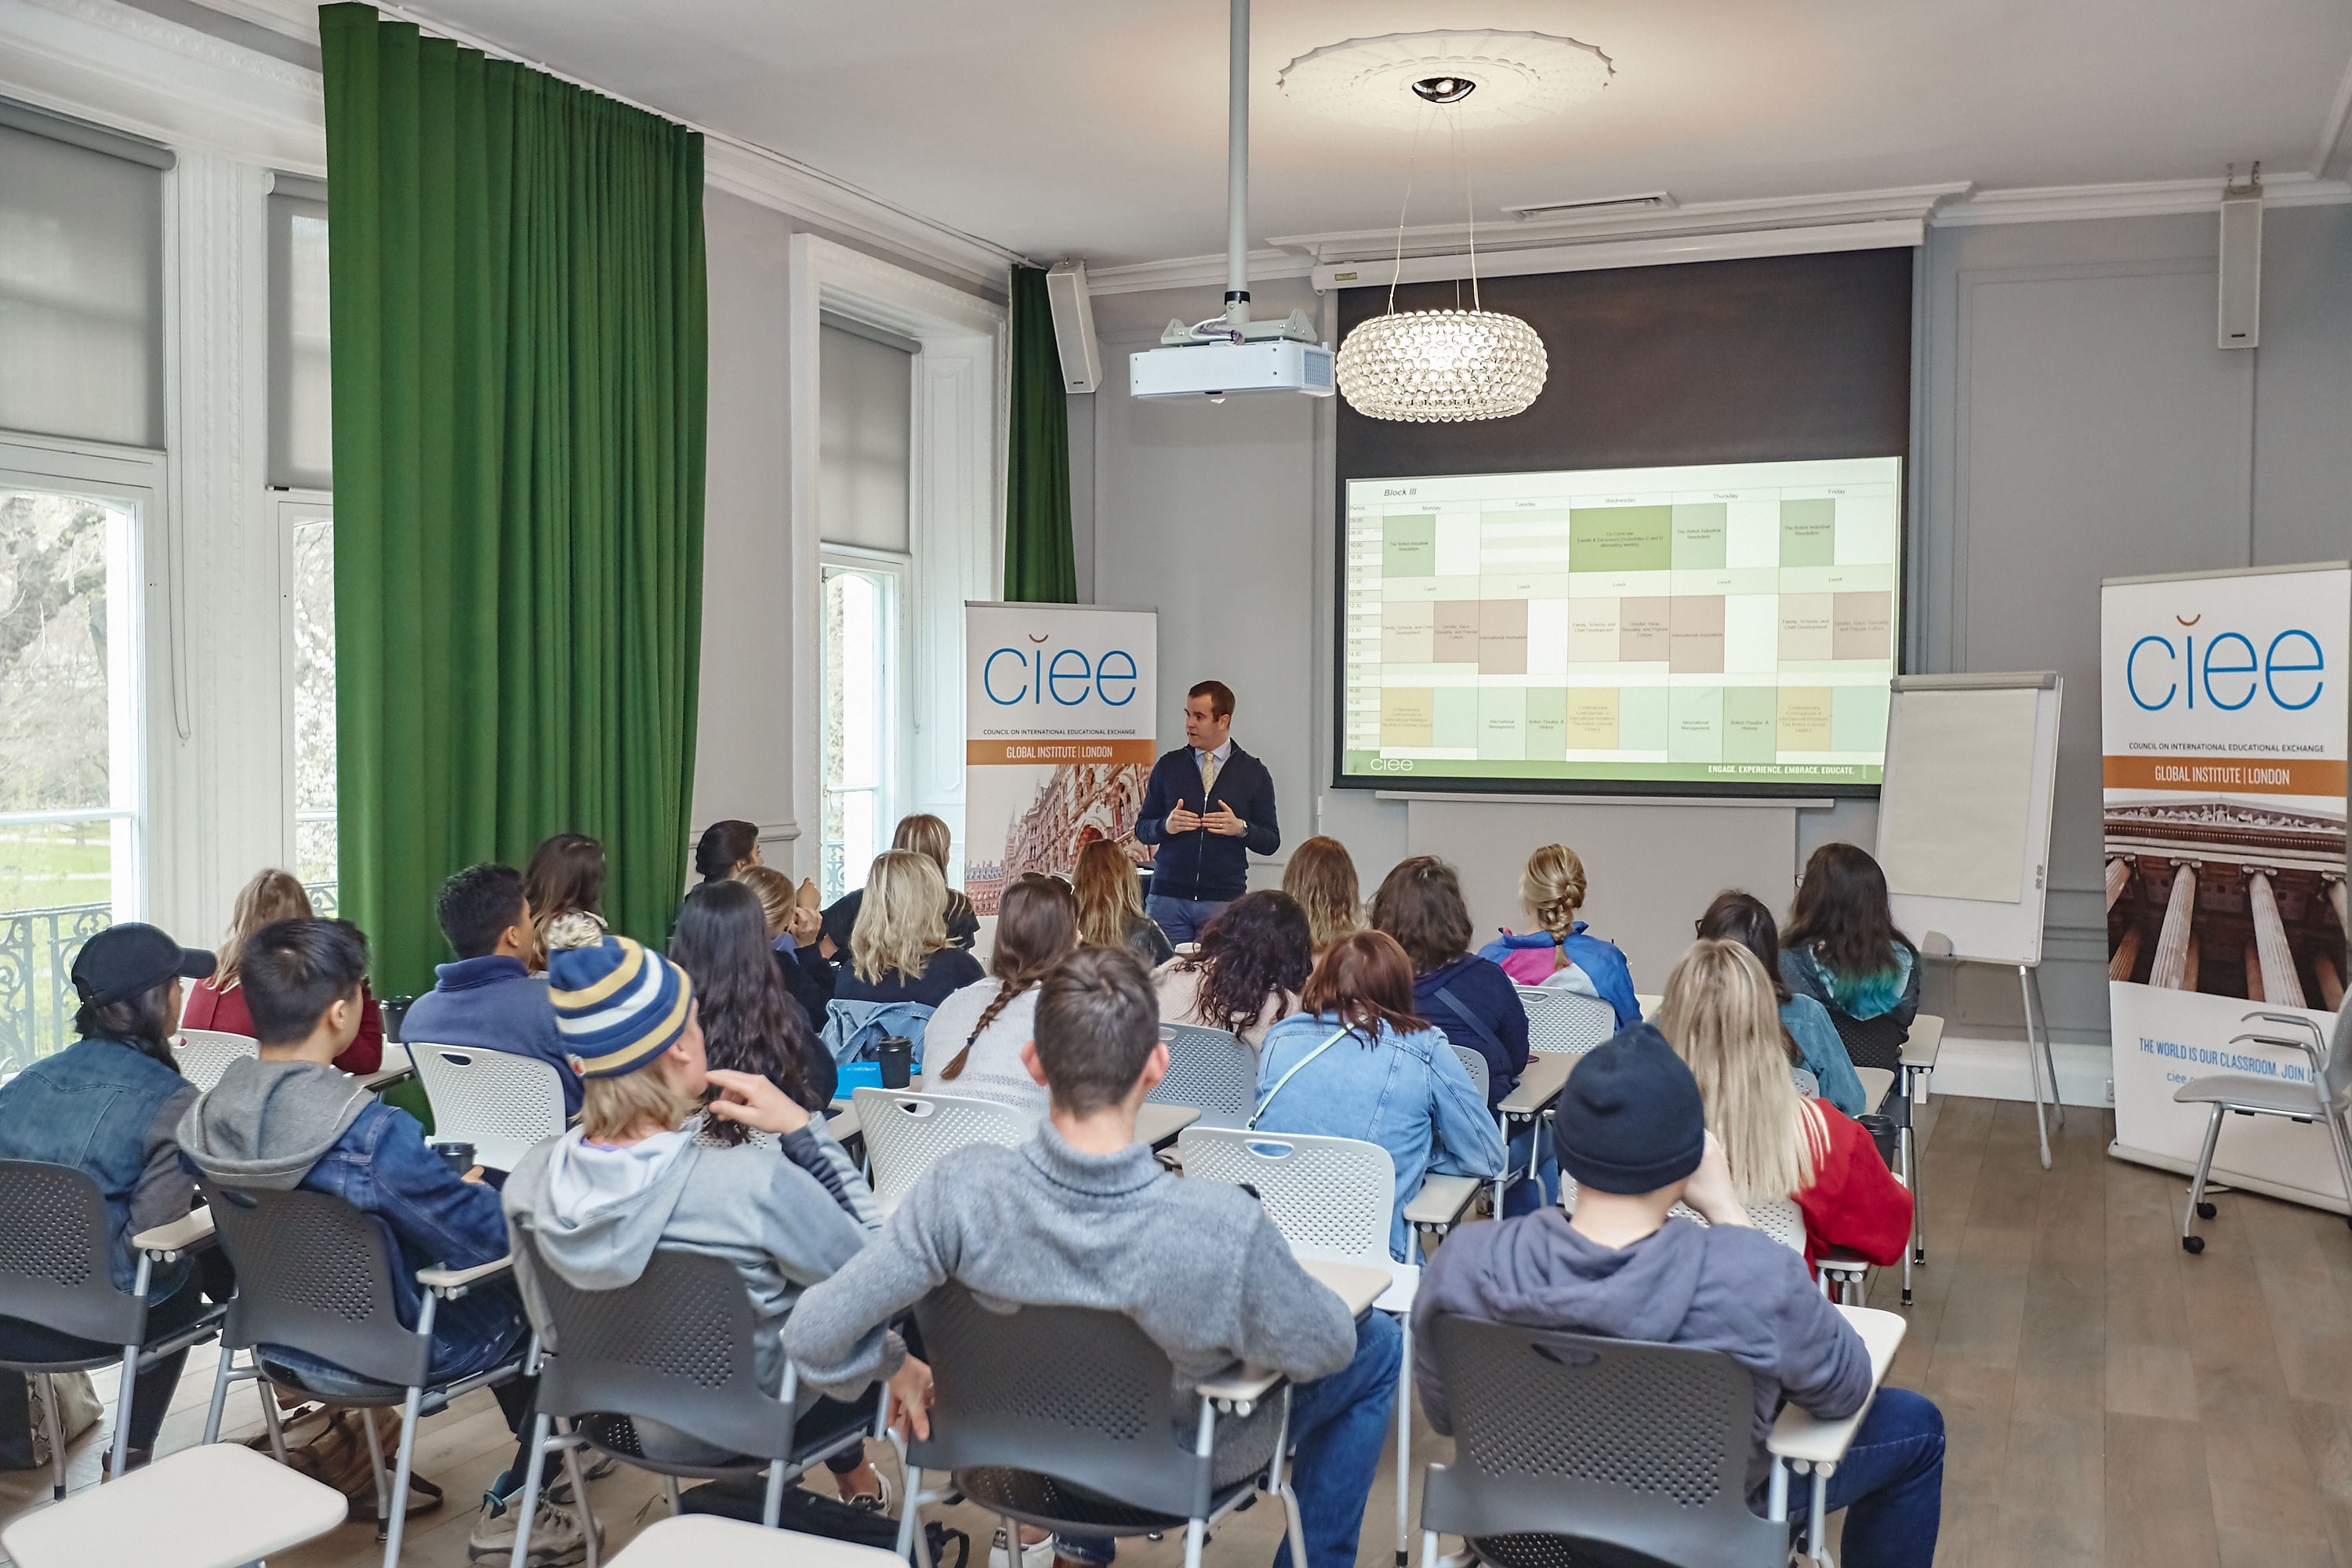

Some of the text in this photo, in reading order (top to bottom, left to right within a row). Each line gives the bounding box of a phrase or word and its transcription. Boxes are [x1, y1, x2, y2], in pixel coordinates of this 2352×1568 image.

[984, 634, 1137, 706] ciee
[2127, 614, 2324, 711] ciee
[1006, 746, 1112, 759] GLOBAL INSTITUTE LONDON
[2170, 742, 2227, 751] INTERNATIONAL
[2281, 744, 2325, 753] EXCHANGE
[1739, 765, 1783, 774] EXPERIENCE.
[1784, 766, 1820, 775] EMBRACE.
[1821, 766, 1855, 775] EDUCATE.
[2154, 765, 2290, 786] GLOBAL INSTITUTE LONDON
[2139, 1037, 2154, 1054] THE
[2156, 1040, 2187, 1059] WORLD
[2189, 1047, 2198, 1062] IS
[2199, 1048, 2218, 1065] OUR
[2220, 1051, 2278, 1076] CLASSROOM.
[2281, 1065, 2304, 1081] JOIN
